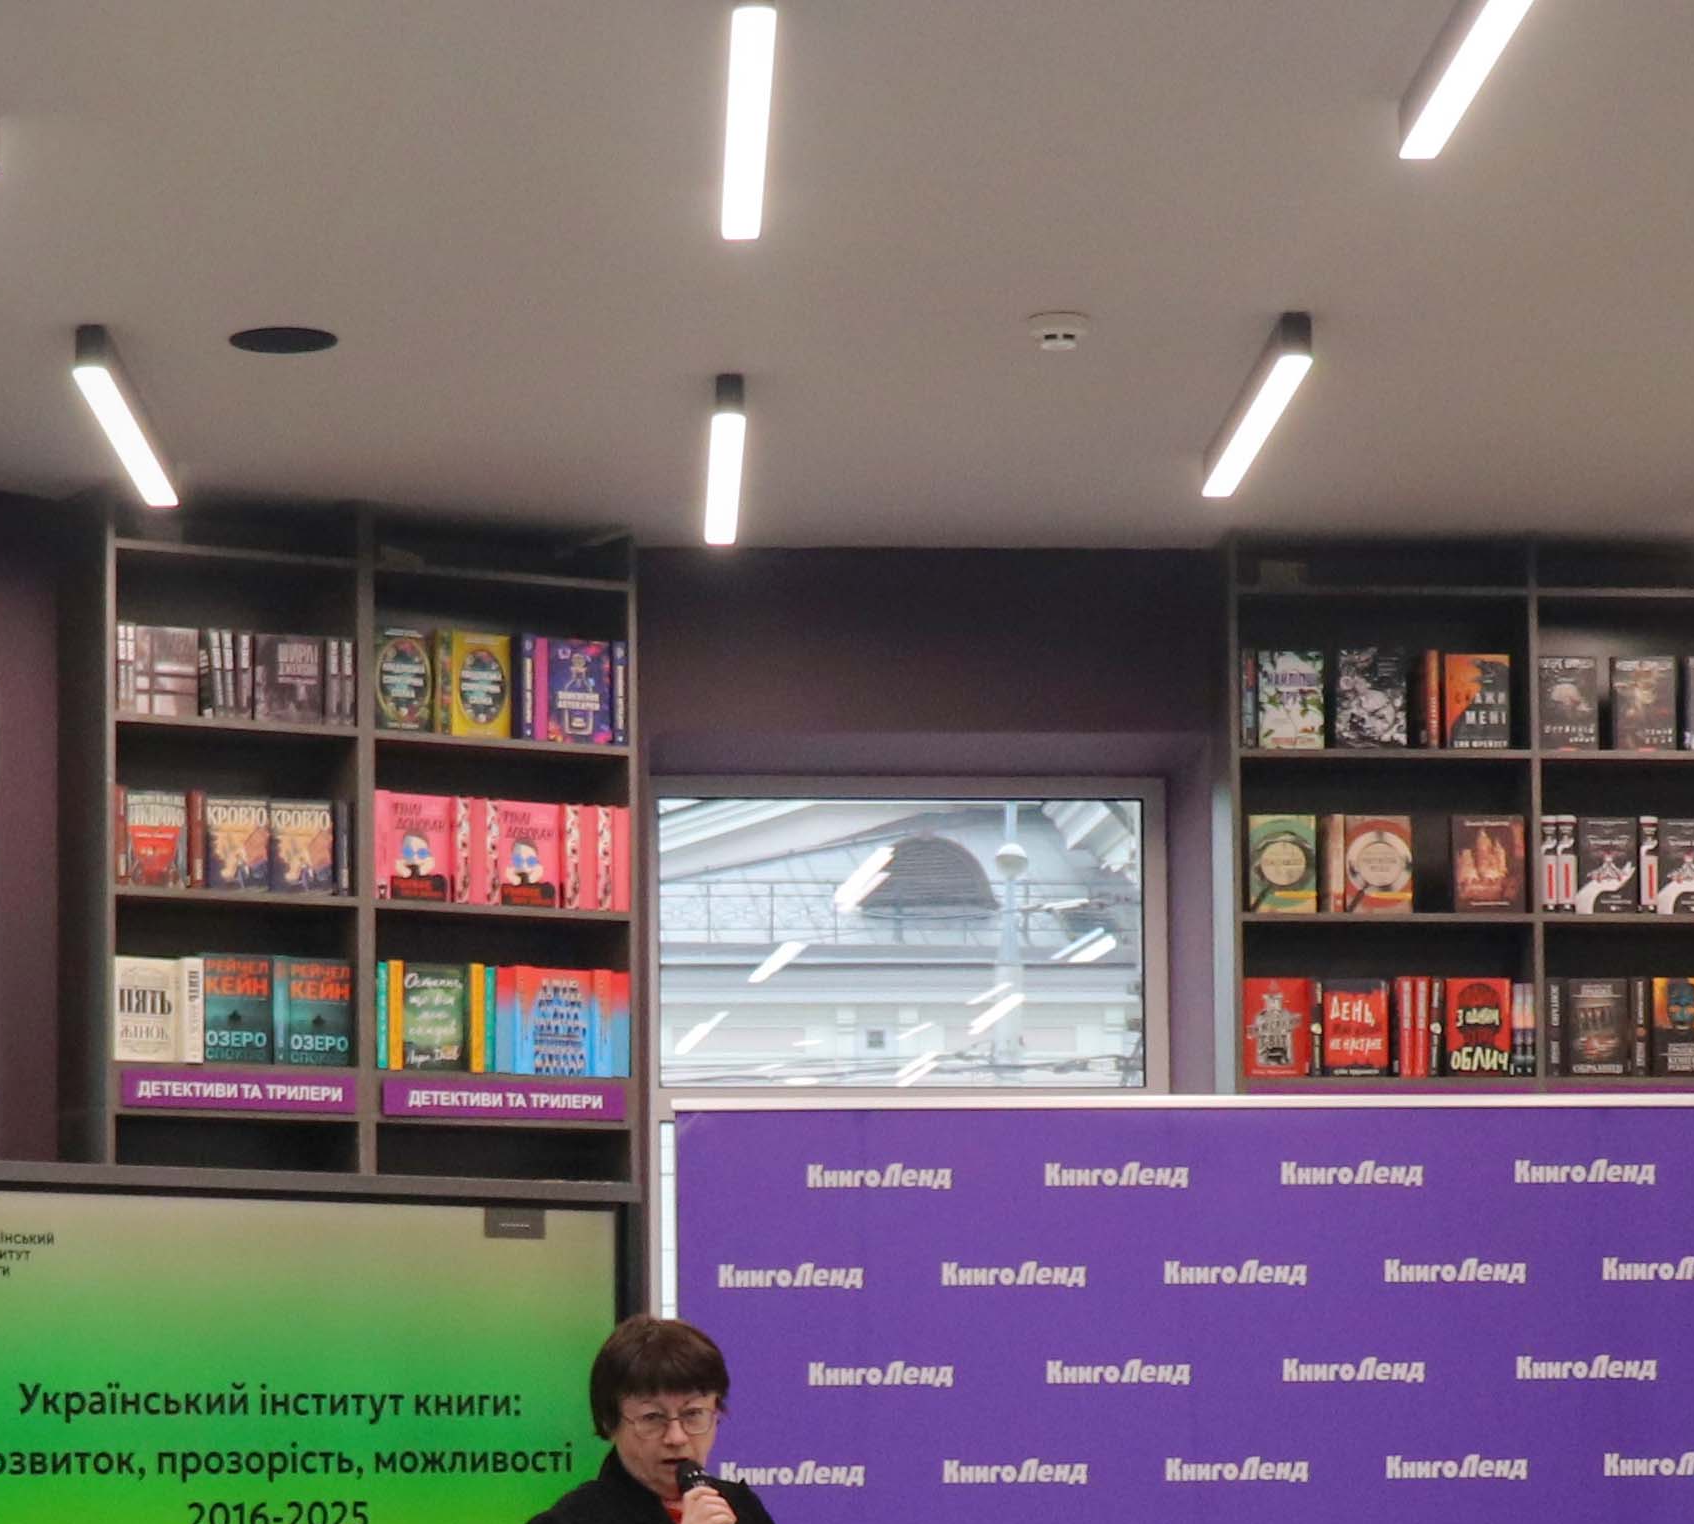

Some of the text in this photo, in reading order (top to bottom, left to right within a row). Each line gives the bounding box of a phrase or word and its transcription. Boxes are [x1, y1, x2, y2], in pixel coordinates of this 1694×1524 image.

[205, 974, 270, 997] КЕЙН
[290, 979, 351, 1001] КЕЙН
[1329, 995, 1376, 1025] ДЕНЬ,
[205, 1030, 267, 1048] ОЗЕРО
[290, 1035, 349, 1053] ОЗЕРО
[1450, 1045, 1509, 1071] ОБЛИЧ
[137, 1080, 343, 1103] ДЕТЕКТИВИ ТА ТРИЛЕРИ
[408, 1090, 604, 1110] ДЕТЕКТИВИ ТА ТРИЛЕРИ
[806, 1162, 953, 1190] КнигоЛенд
[1044, 1161, 1190, 1189] КнигоЛенд
[1280, 1159, 1424, 1187] КнигоЛенд
[1514, 1158, 1656, 1185] КнигоЛенд
[718, 1262, 864, 1290] КнигоЛенд
[940, 1260, 1087, 1288] КнигоЛенд
[1163, 1259, 1308, 1286] КнигоЛенд
[1384, 1257, 1527, 1284] КнигоЛенд
[808, 1360, 954, 1388] КнигоЛенд
[1046, 1358, 1191, 1386] КнигоЛенд
[1282, 1356, 1426, 1383] КнигоЛенд
[1516, 1354, 1657, 1381] КнигоЛенд
[18, 1381, 523, 1424] Український інститут книги:
[156, 1442, 364, 1483] прозорість,
[373, 1441, 573, 1475] можливості
[942, 1458, 1088, 1485] КнигоЛенд
[1164, 1455, 1309, 1483] КнигоЛенд
[1385, 1453, 1528, 1480] КнигоЛенд
